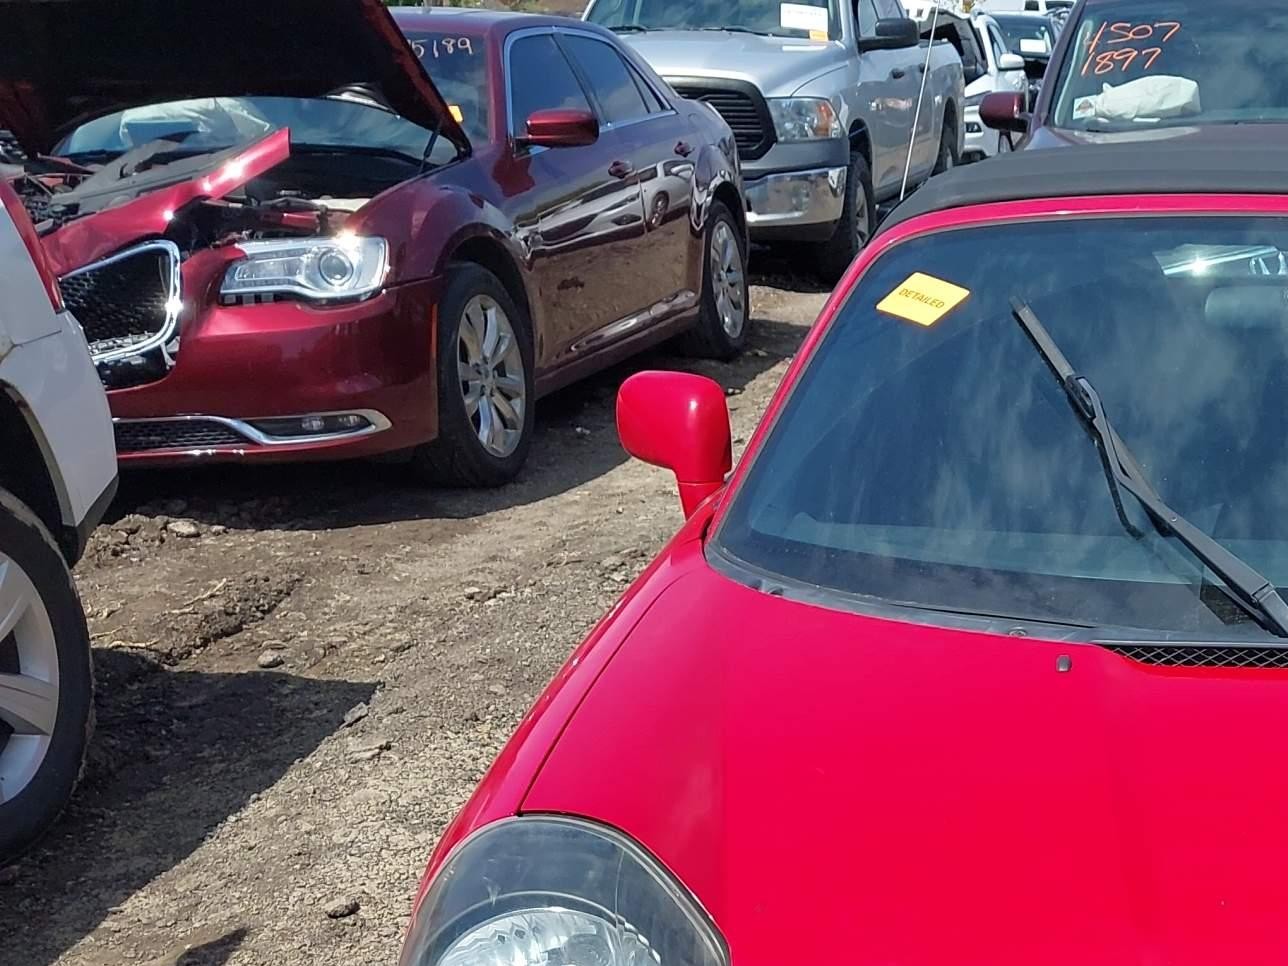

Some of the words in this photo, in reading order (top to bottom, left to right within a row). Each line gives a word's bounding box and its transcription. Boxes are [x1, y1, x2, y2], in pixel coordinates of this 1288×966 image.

[407, 36, 474, 59] 5189
[1081, 47, 1162, 76] 1897
[898, 287, 946, 310] DETAILED
